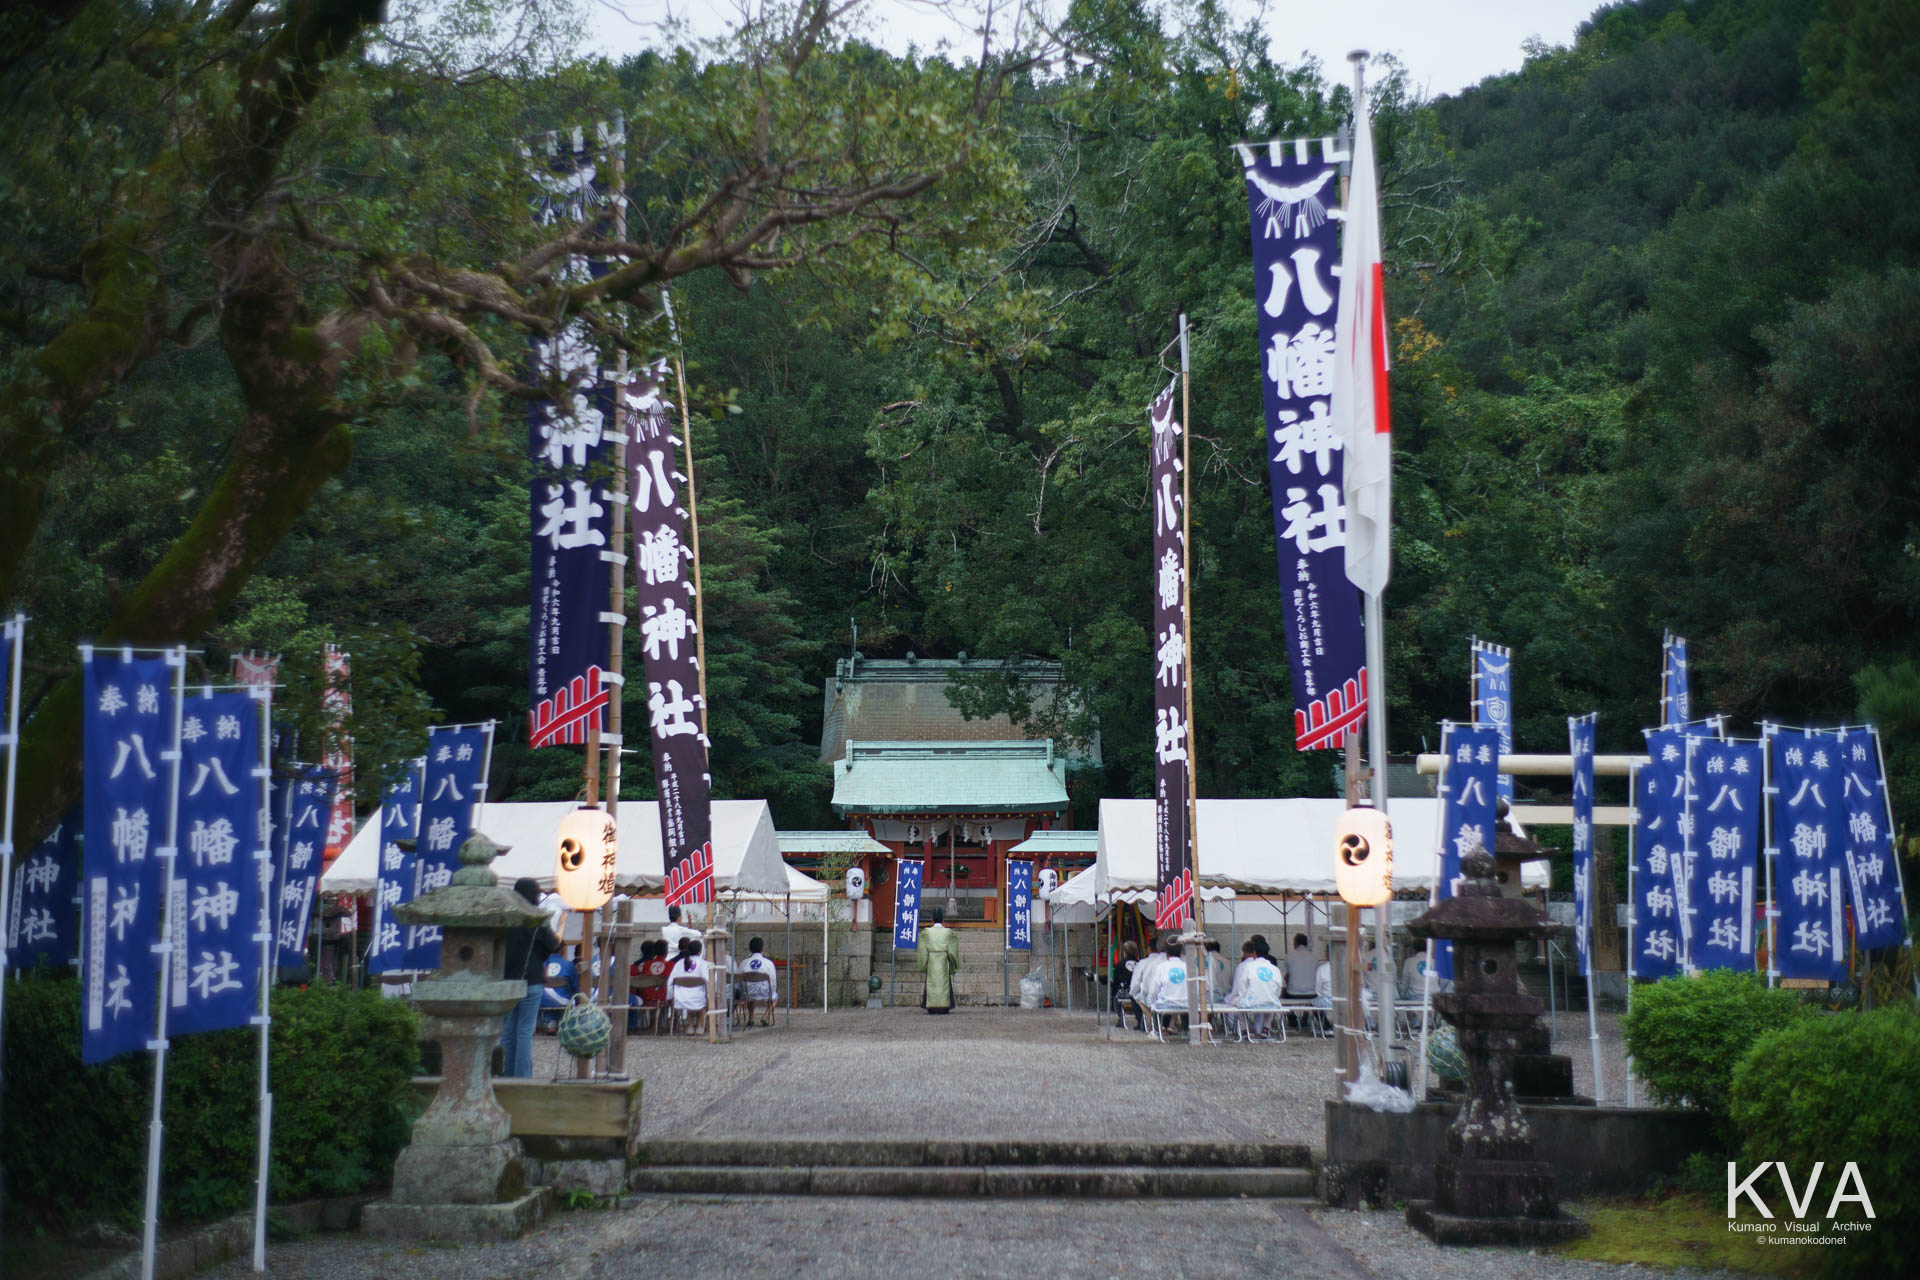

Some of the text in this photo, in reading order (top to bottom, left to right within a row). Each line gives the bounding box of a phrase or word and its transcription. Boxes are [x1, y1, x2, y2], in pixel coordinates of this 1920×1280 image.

[537, 254, 606, 549] 幡神社
[1264, 247, 1346, 554] 八幡神社
[552, 579, 560, 654] 令和六年九月吉日
[634, 450, 698, 740] 八幡神社
[1155, 472, 1188, 766] 八幡神社
[1307, 582, 1324, 655] 令和六年九月吉日
[99, 684, 159, 716] 奉納
[182, 715, 241, 743] 奉納
[435, 743, 474, 764] 奉納
[20, 824, 63, 945] 神社
[188, 757, 243, 999] 八幡神社
